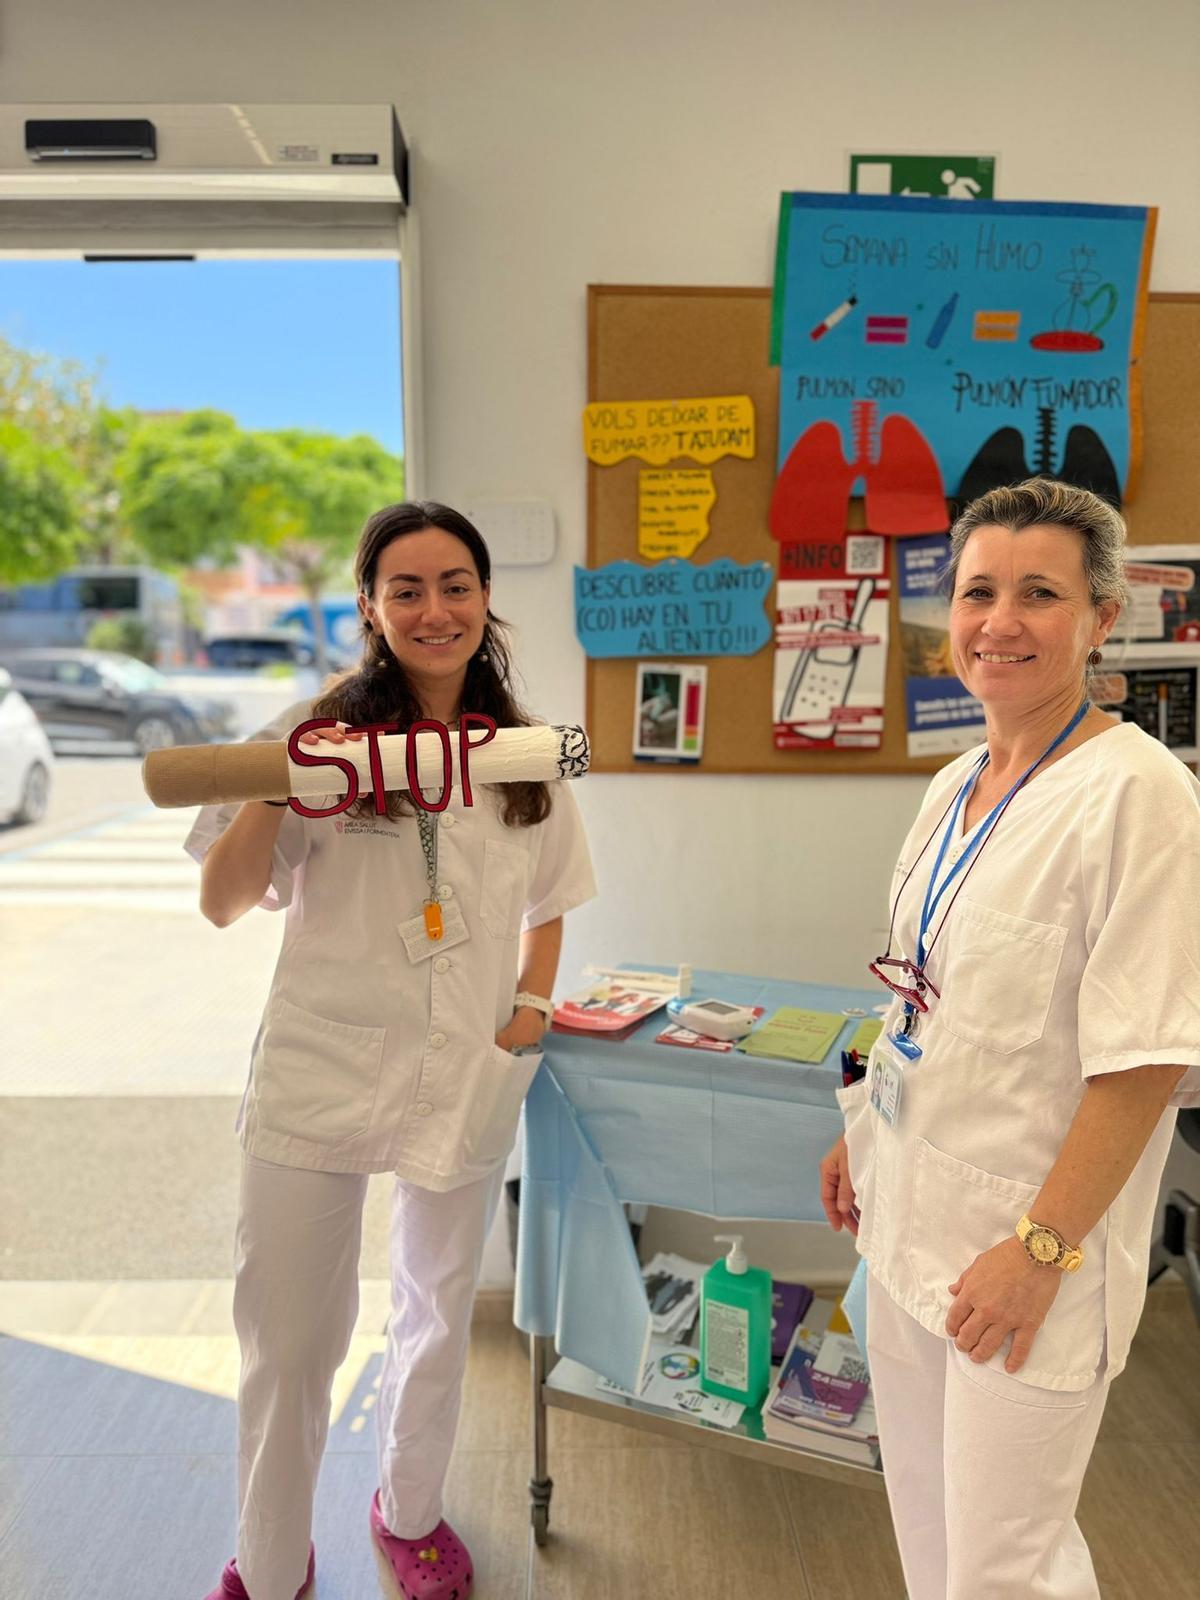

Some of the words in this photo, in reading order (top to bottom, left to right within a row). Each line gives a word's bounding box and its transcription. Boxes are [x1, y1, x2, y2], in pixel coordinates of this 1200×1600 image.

[975, 223, 1043, 272] HUMO
[866, 375, 906, 399] SANO
[1030, 375, 1124, 412] FUMADOR
[587, 407, 638, 430] VOLS
[716, 405, 740, 422] DE
[579, 572, 681, 600] DESCUBRE
[577, 604, 616, 632] (CO)
[621, 604, 656, 629] HAY
[662, 602, 690, 627] EN
[699, 600, 733, 626] TU
[637, 625, 758, 652] ALIENTO!!!
[287, 713, 497, 818] STOP
